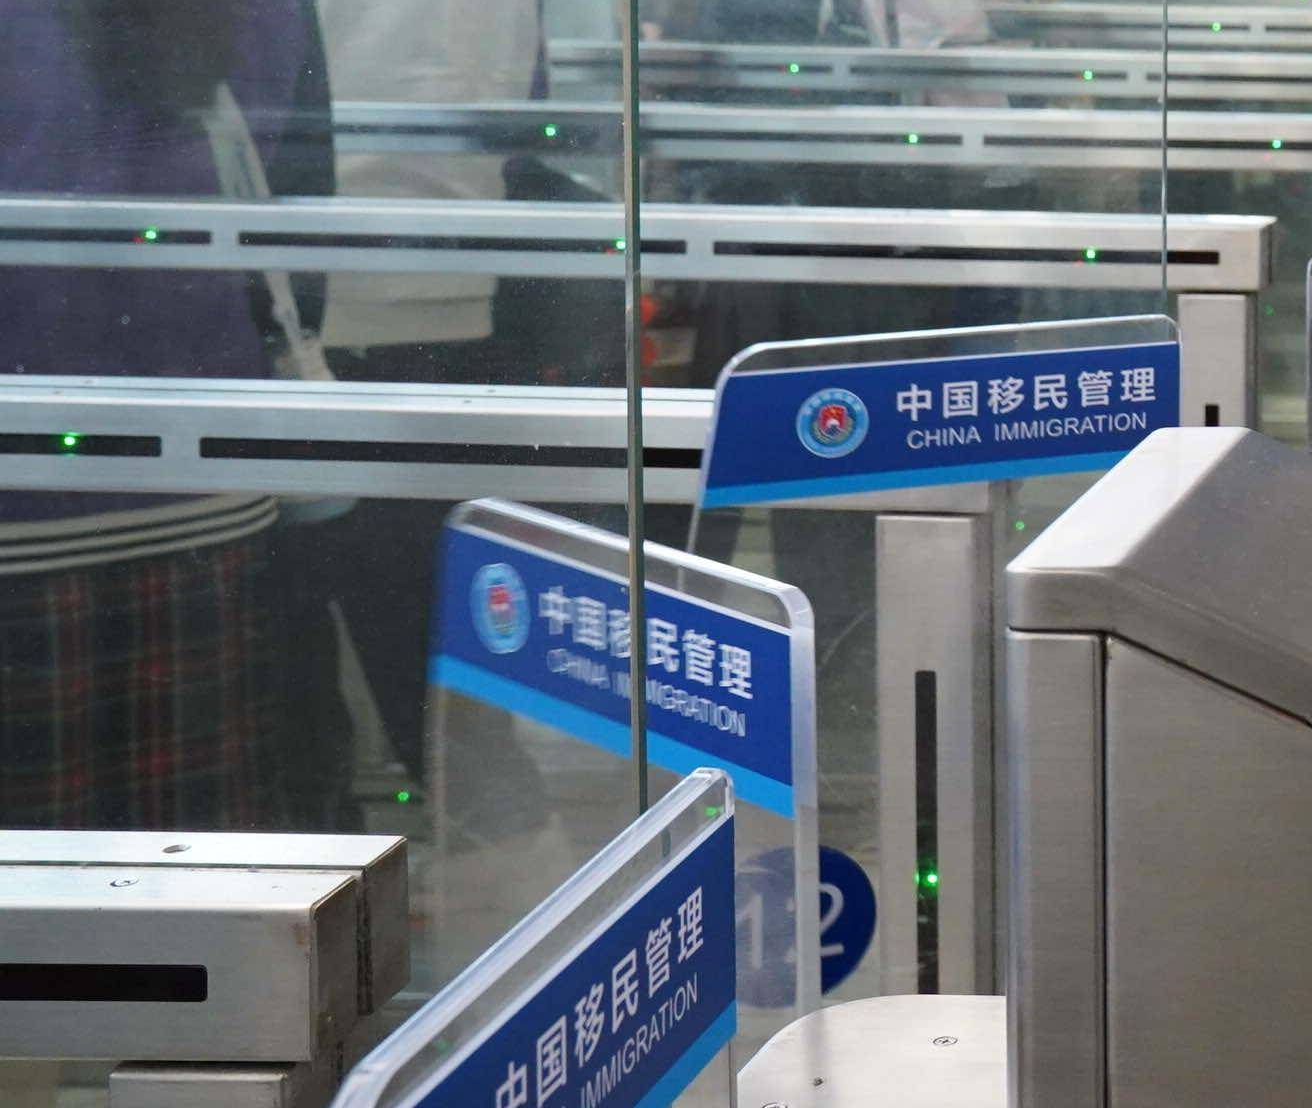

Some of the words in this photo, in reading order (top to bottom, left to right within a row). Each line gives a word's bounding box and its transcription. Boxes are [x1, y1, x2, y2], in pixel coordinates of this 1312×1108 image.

[896, 367, 1156, 422] 中国移民管理
[906, 425, 982, 450] CHINA
[994, 412, 1147, 442] IMMIGRATION
[538, 585, 753, 700] 中国移民管理
[546, 648, 611, 689] CHINA
[495, 885, 704, 1108] 中国移民管理
[579, 972, 699, 1108] IMMIGRATION
